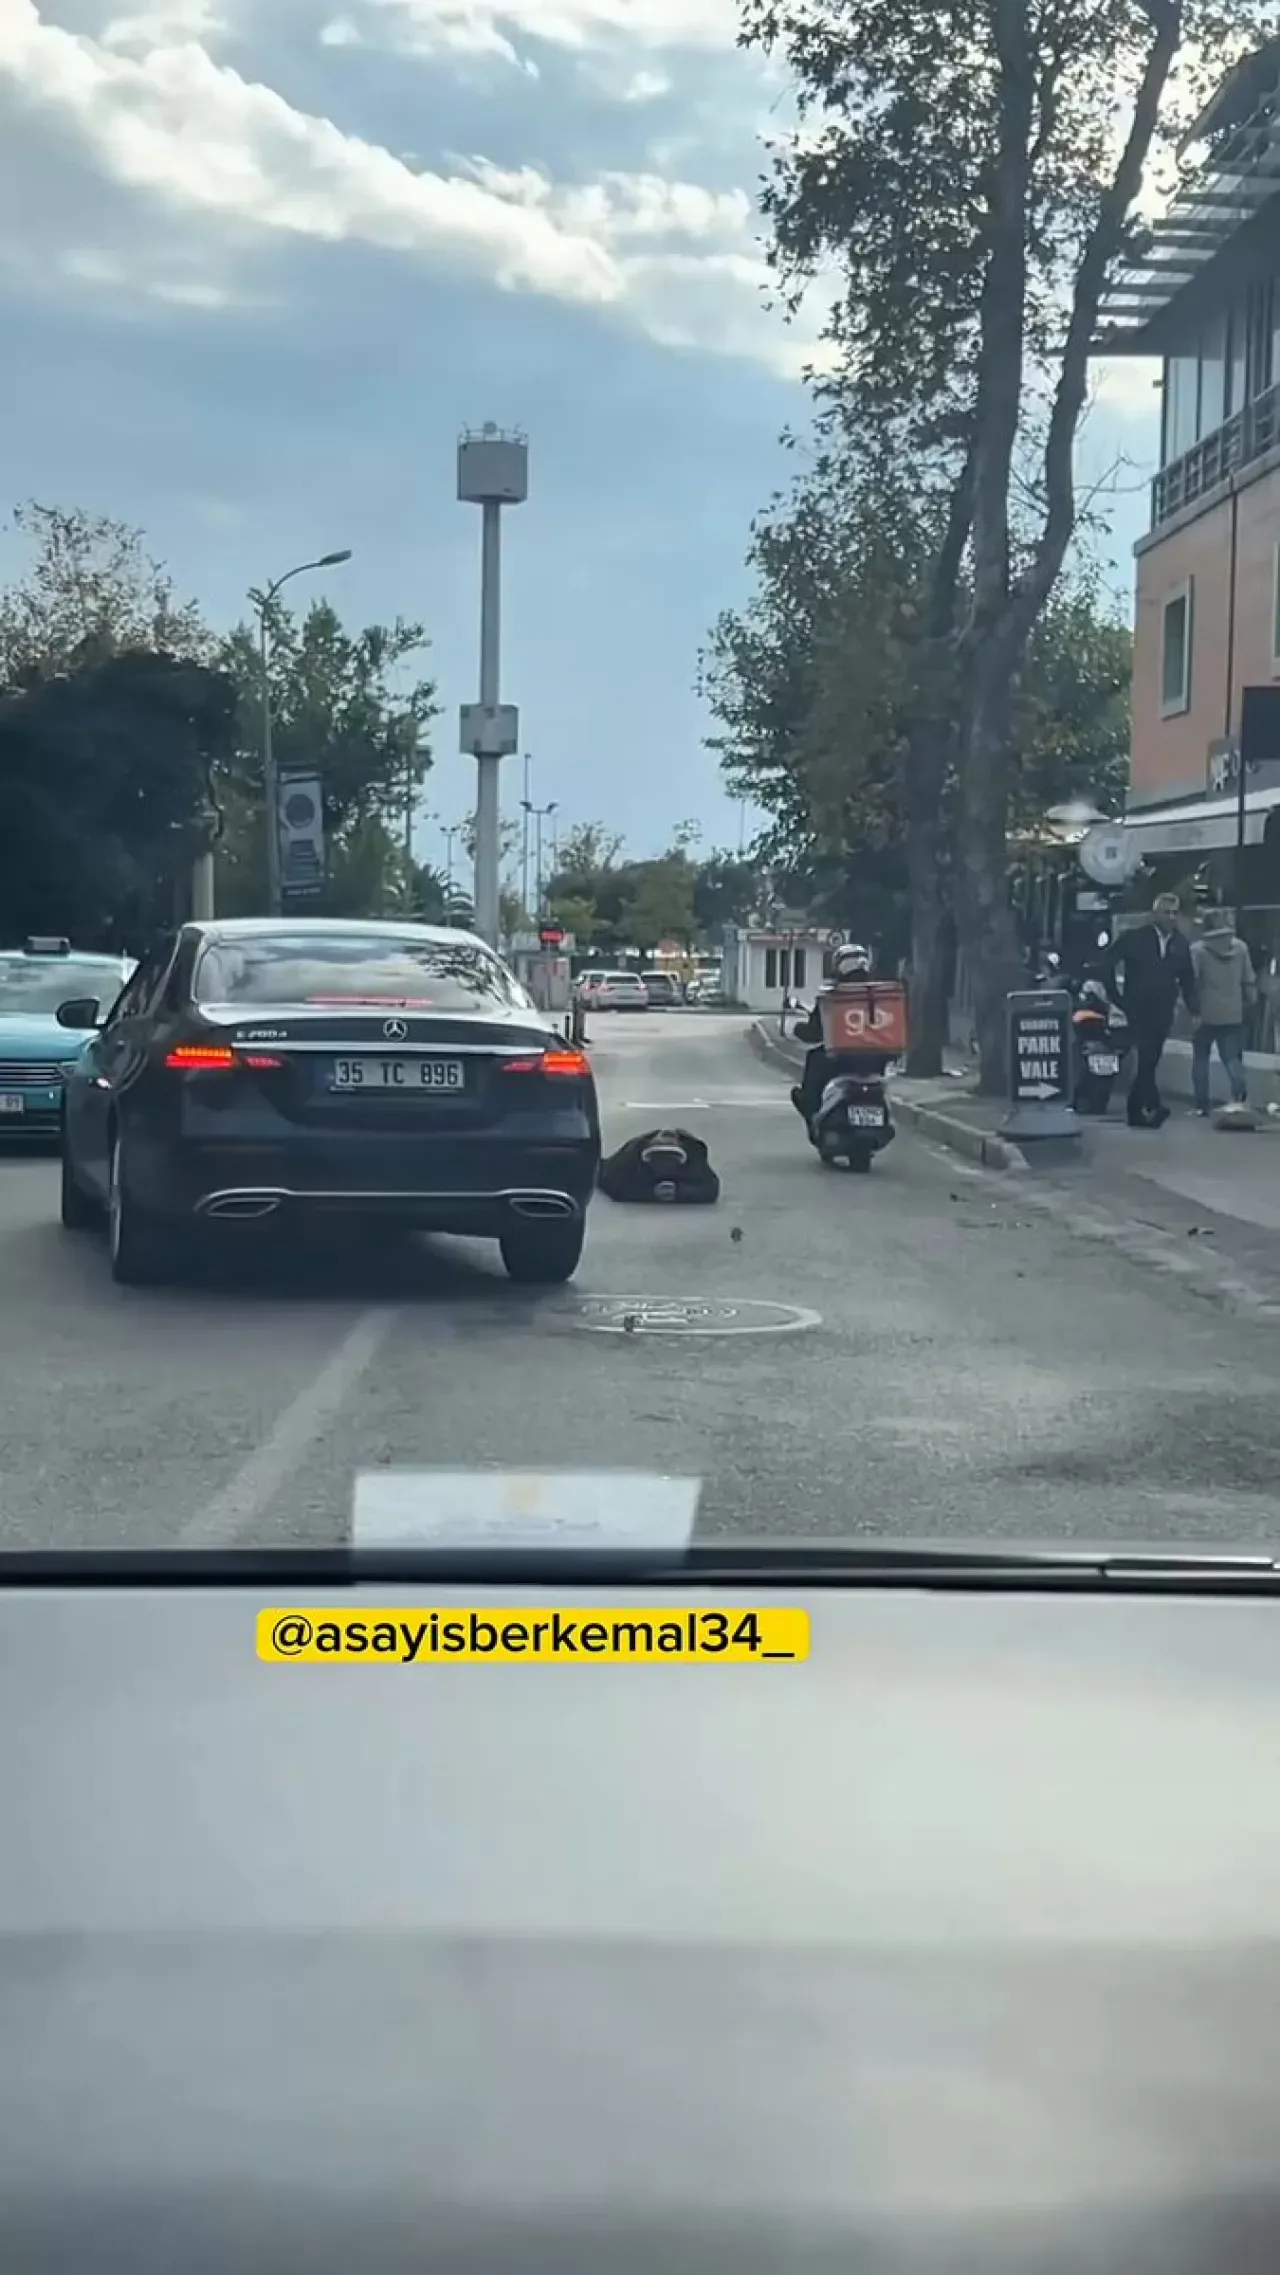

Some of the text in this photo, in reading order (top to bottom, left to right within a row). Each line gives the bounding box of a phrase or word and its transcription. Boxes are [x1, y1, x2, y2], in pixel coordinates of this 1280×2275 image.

[1018, 1036, 1060, 1054] PARK
[338, 1061, 458, 1085] 35 TC 896
[1020, 1061, 1059, 1079] VALE
